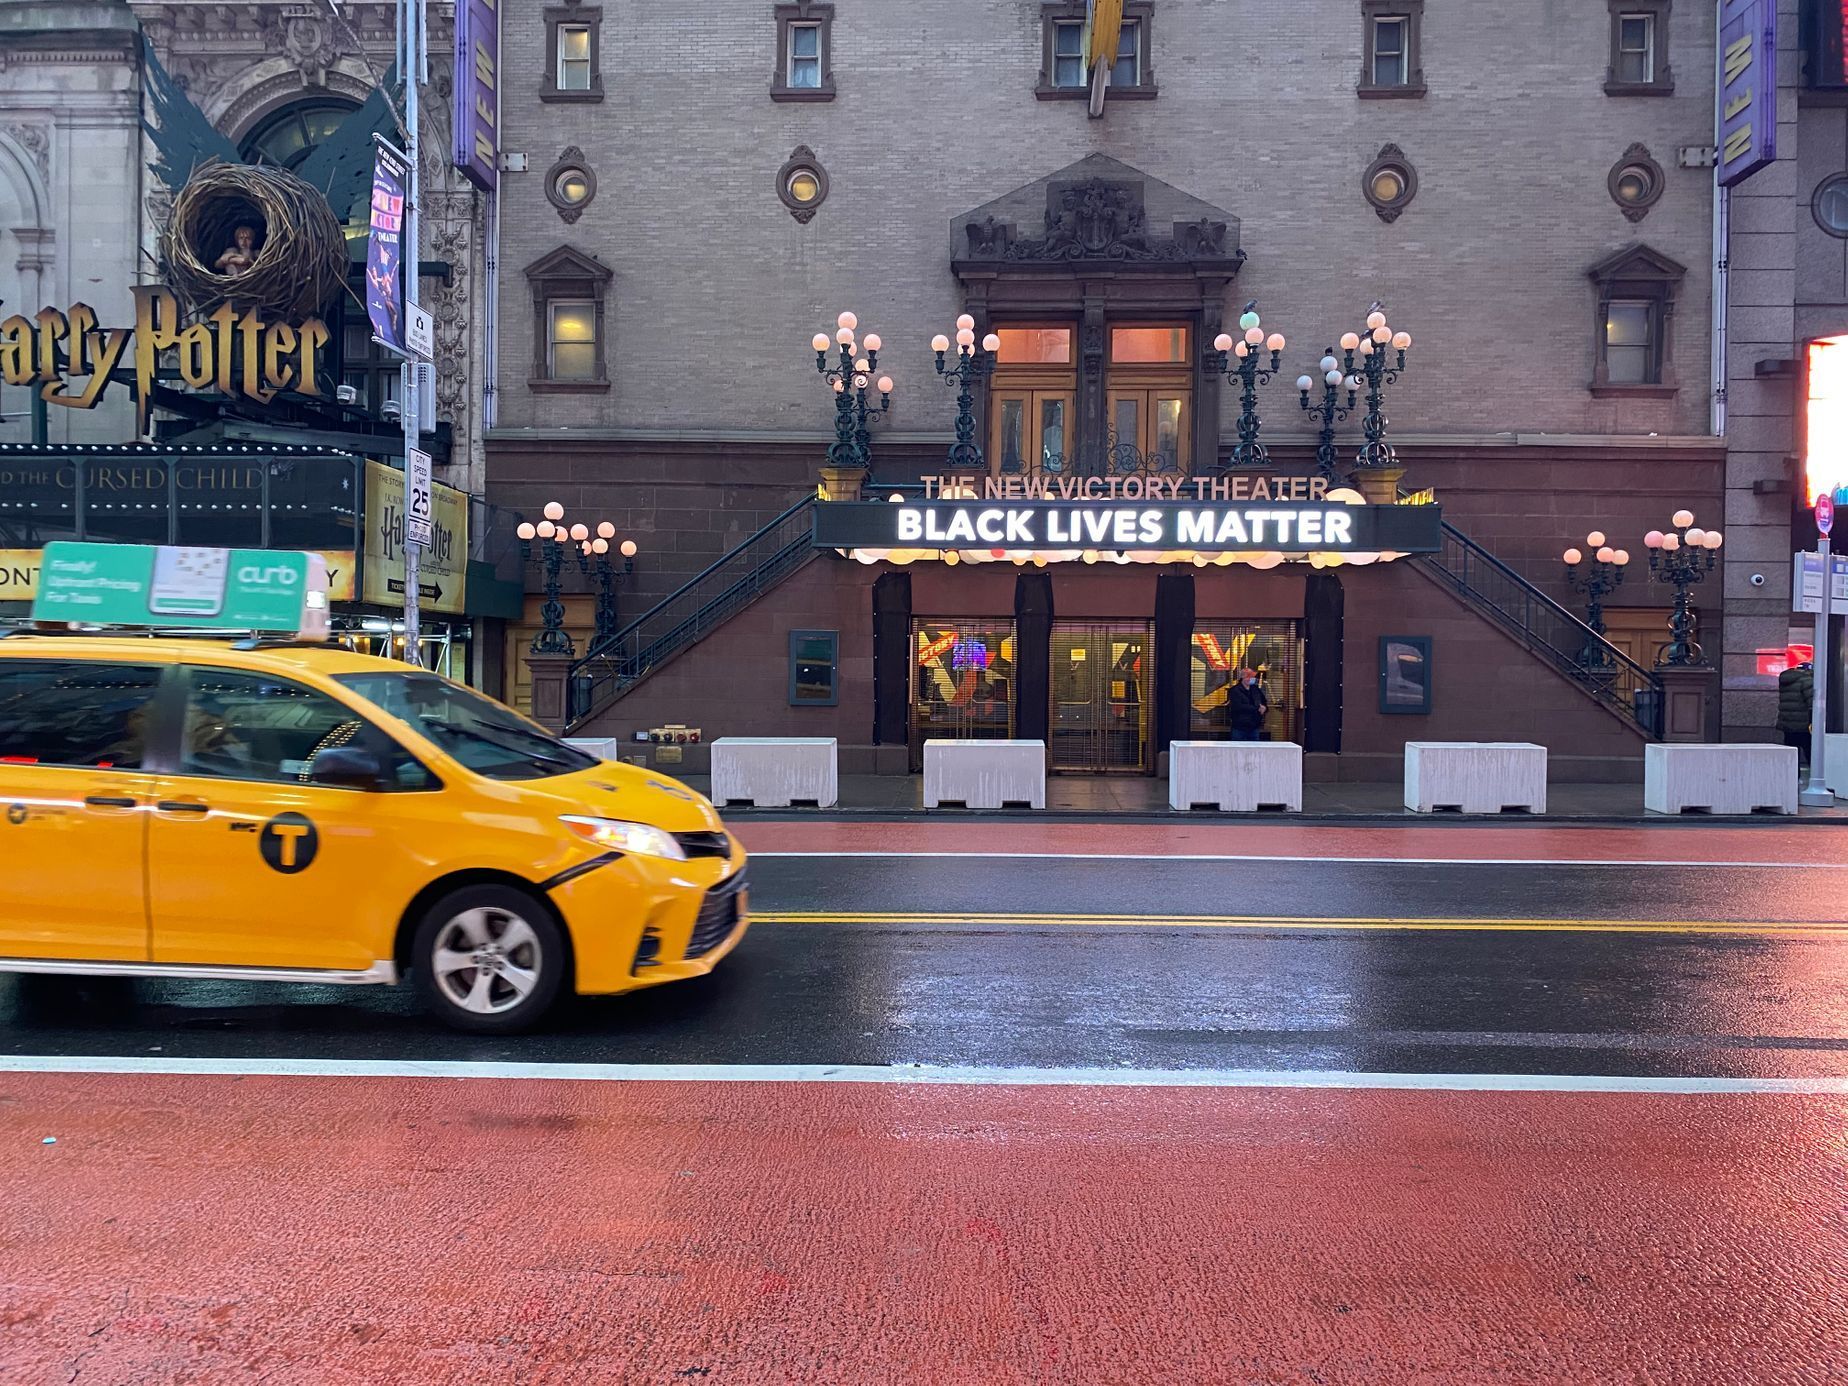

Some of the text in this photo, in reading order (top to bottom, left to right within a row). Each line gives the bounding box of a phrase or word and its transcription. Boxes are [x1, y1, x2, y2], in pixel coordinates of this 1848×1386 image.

[475, 38, 494, 170] NEW
[1724, 33, 1753, 165] NEW
[0, 286, 330, 434] arry Potter
[413, 464, 428, 477] SPEED
[416, 454, 425, 465] CITY
[18, 471, 49, 485] THE
[55, 466, 165, 491] CURSED
[175, 466, 265, 490] CHILD
[415, 476, 426, 487] LIMIT
[920, 475, 1329, 501] THE NEW VICTORY THEATER
[412, 488, 429, 516] 25
[898, 508, 1352, 543] BLACK LIVES MATTER
[427, 519, 453, 562] otter
[237, 565, 298, 585] curb
[919, 635, 956, 662] ICTORY
[271, 823, 310, 866] T
